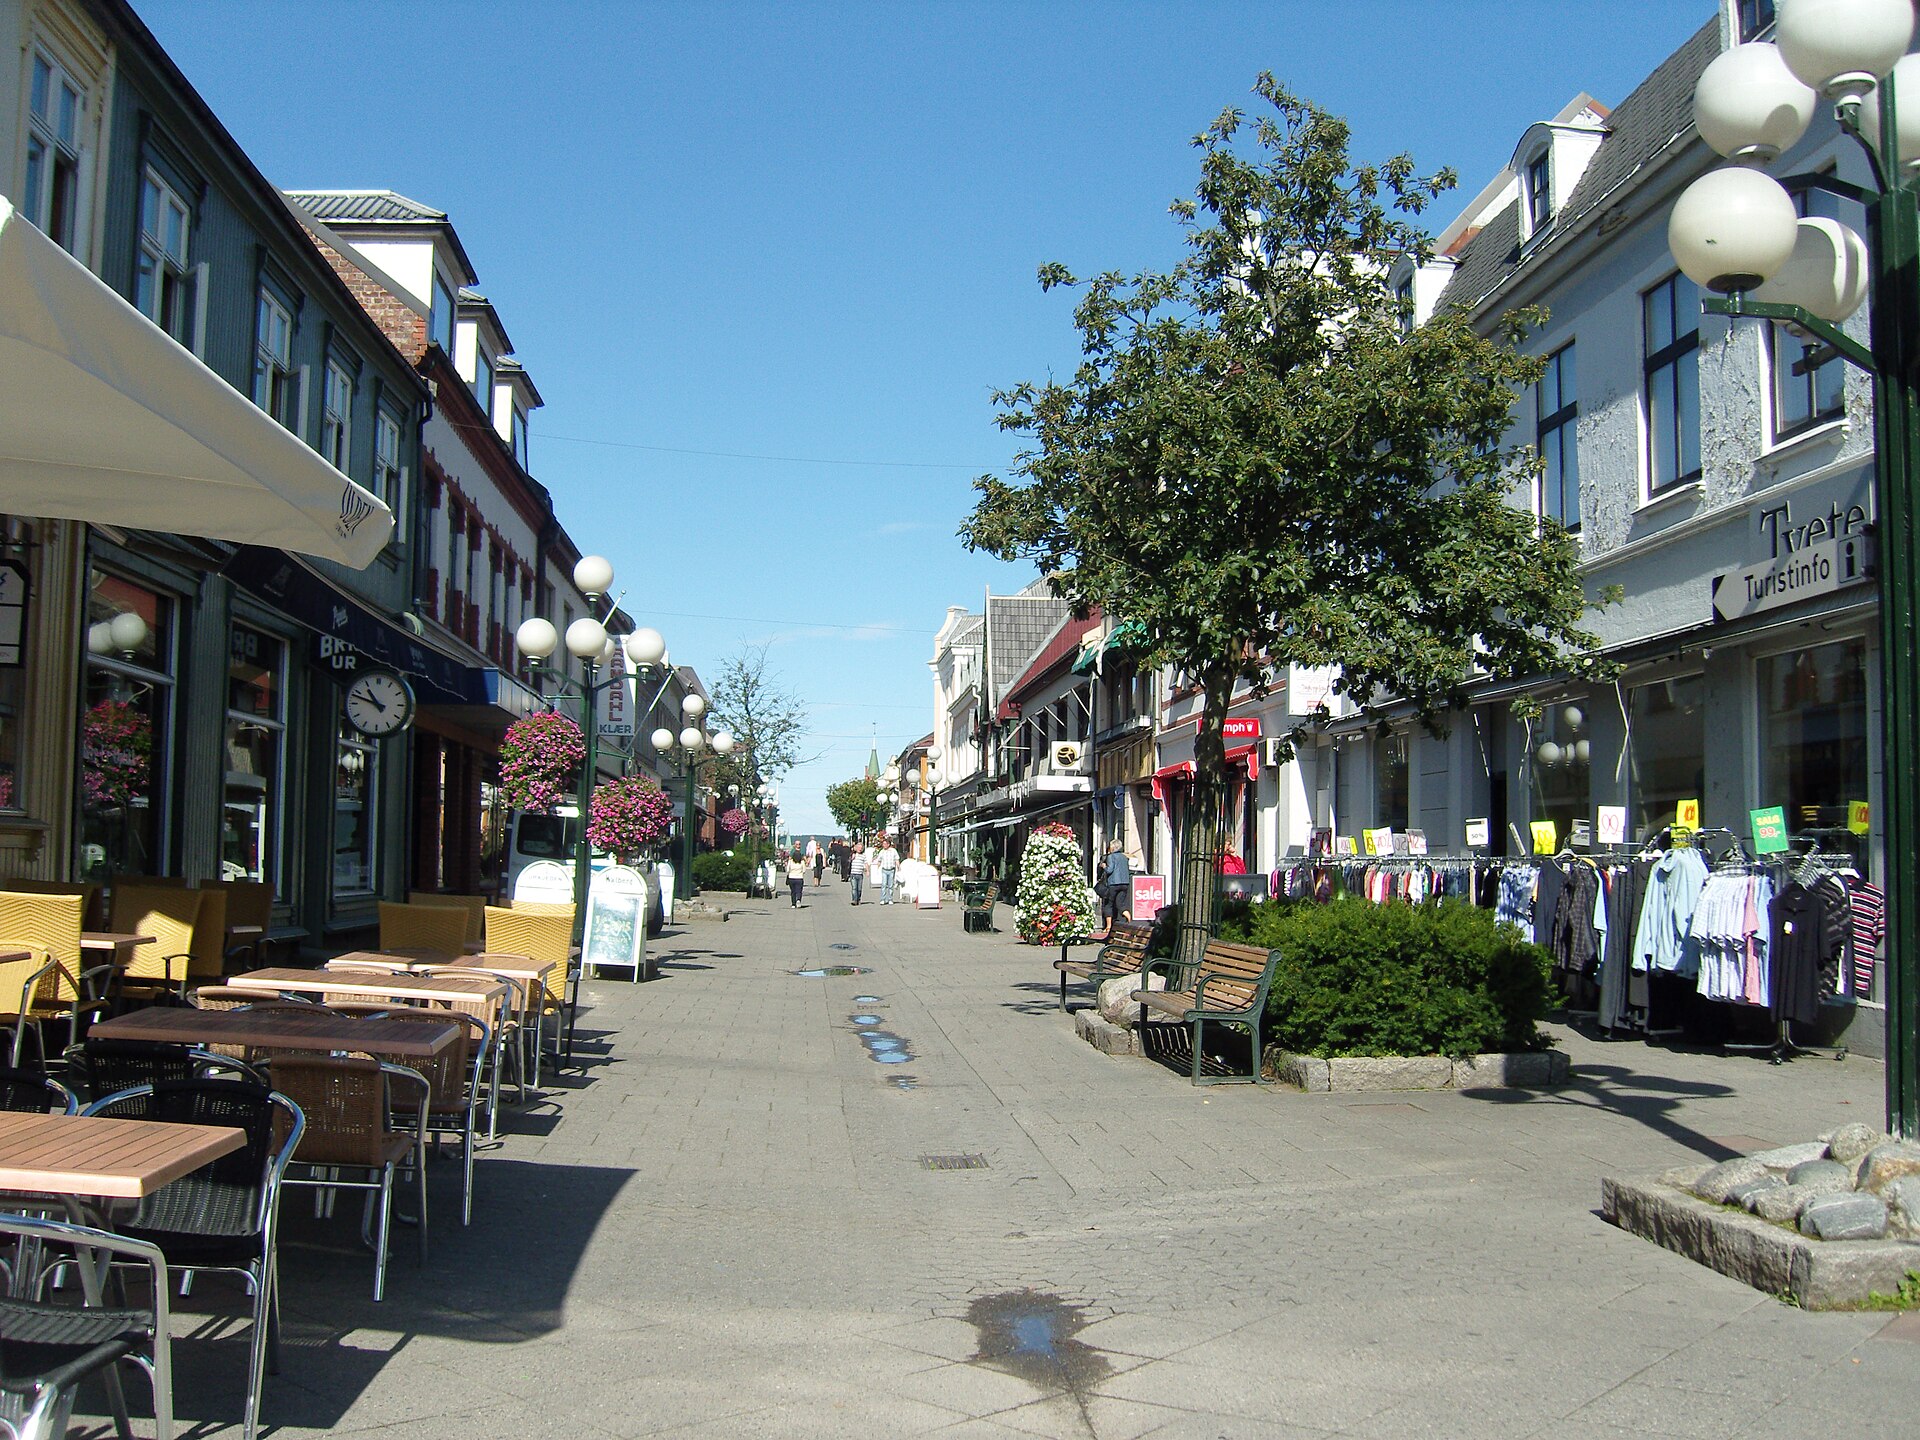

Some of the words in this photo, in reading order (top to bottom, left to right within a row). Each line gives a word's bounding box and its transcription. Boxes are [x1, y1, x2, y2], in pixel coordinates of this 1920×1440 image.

[1744, 552, 1831, 603] Turistinfo
[332, 655, 356, 670] UR
[599, 724, 632, 734] KLÆR
[1135, 885, 1162, 901] sale
